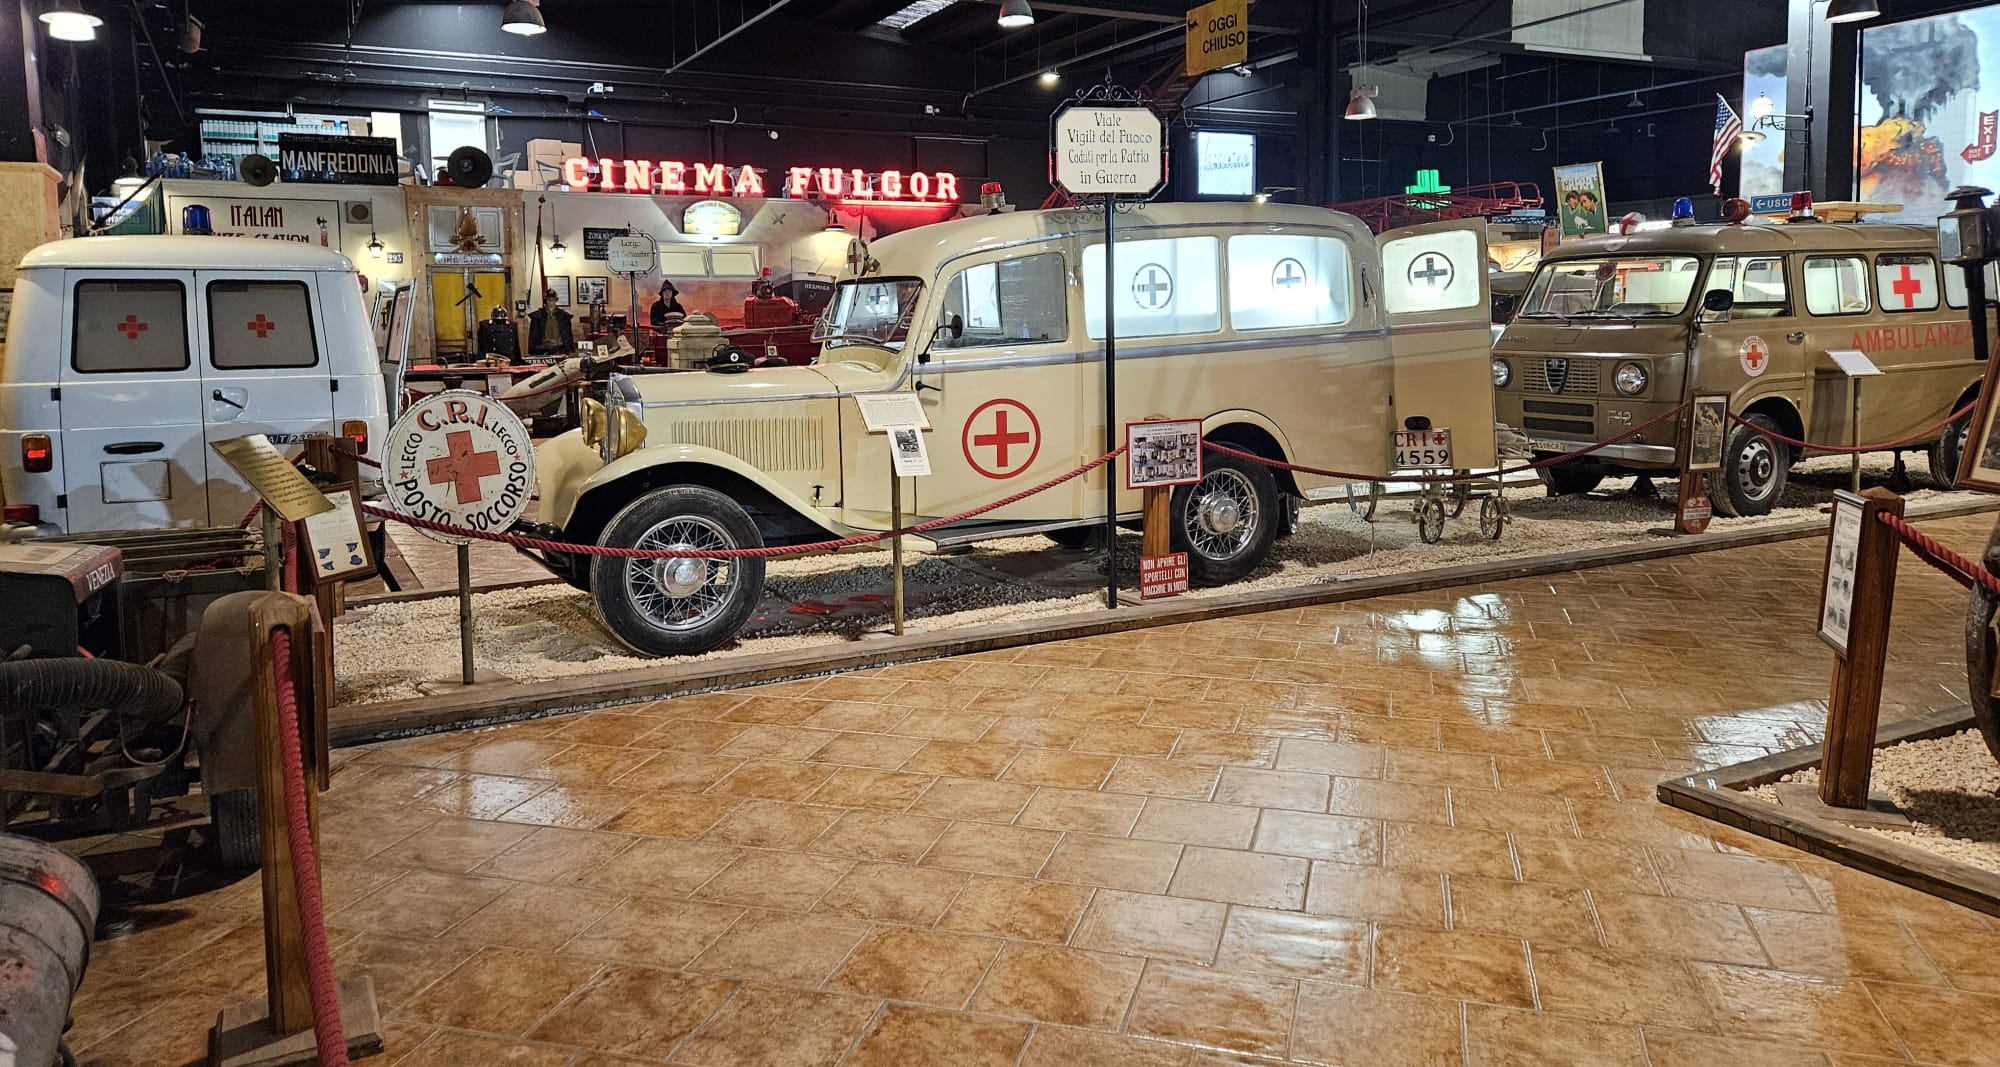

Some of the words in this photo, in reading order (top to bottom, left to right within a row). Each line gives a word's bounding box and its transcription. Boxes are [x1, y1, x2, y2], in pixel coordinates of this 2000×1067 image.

[1208, 13, 1238, 33] OGGI
[1202, 31, 1245, 54] CHIUSO
[1094, 112, 1121, 127] Viale
[1067, 128, 1096, 146] Vigili
[1099, 130, 1115, 143] del
[1119, 130, 1153, 144] Fuoco
[1982, 115, 1995, 155] EXIT
[282, 150, 396, 175] MANFREDONIA
[1068, 149, 1094, 164] Caduti
[1121, 149, 1149, 163] Patria
[564, 157, 763, 194] CINEMA
[789, 167, 959, 200] FULGOR
[1080, 171, 1092, 185] in
[1095, 169, 1137, 184] Guerra
[1766, 198, 1792, 208] USCI
[230, 205, 284, 228] ITALIAN
[416, 400, 489, 432] C.R.I.
[490, 421, 518, 456] LECCO
[401, 432, 423, 470] LECCO
[1395, 449, 1449, 466] 4559
[394, 476, 452, 526] POSTO
[465, 461, 527, 531] SOCCORSO
[1143, 558, 1155, 571] NON
[1157, 556, 1176, 569] APRIRE
[1177, 554, 1186, 566] GLI
[85, 561, 116, 593] VENEZIA
[1144, 568, 1173, 584] SPORTELLI
[1174, 567, 1186, 579] CON
[1173, 580, 1187, 592] MOTO
